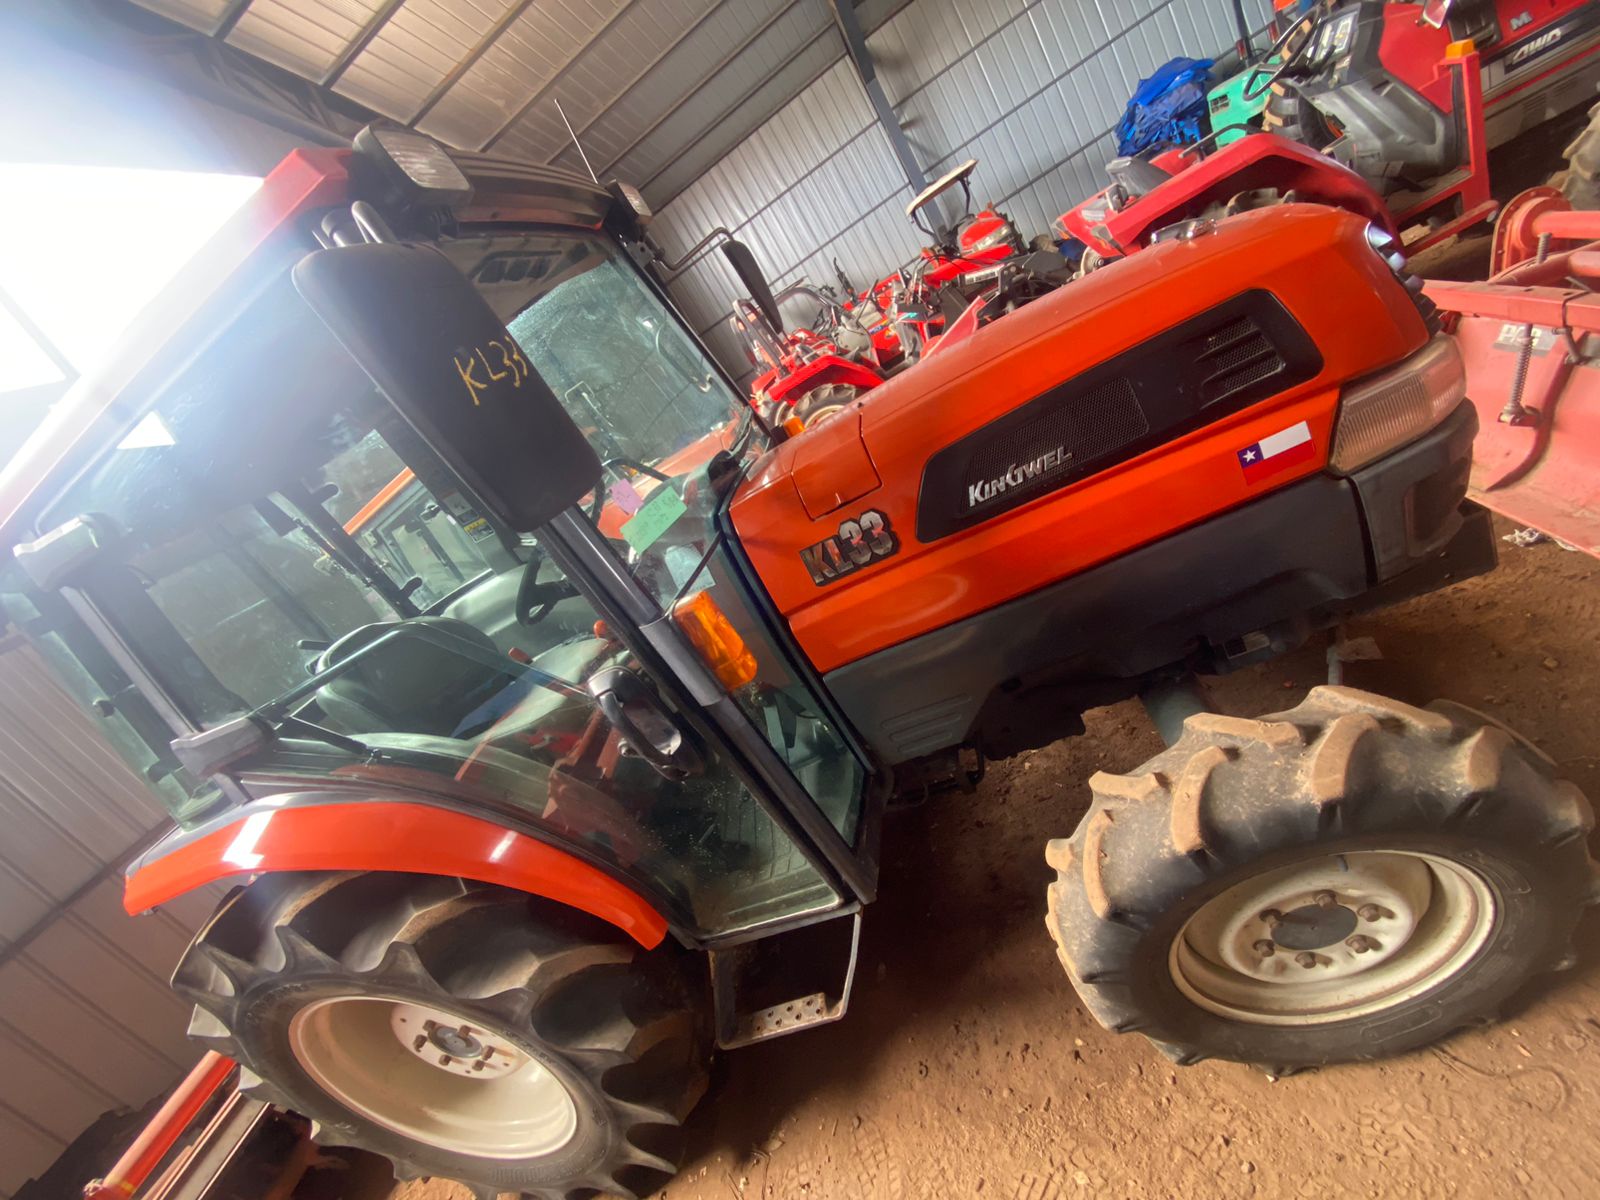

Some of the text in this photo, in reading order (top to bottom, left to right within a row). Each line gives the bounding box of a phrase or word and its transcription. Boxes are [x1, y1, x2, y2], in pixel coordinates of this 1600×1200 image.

[1512, 27, 1562, 63] 4WD
[454, 335, 528, 406] KL33
[968, 446, 1073, 507] KINGWEL
[799, 510, 896, 585] KL33
